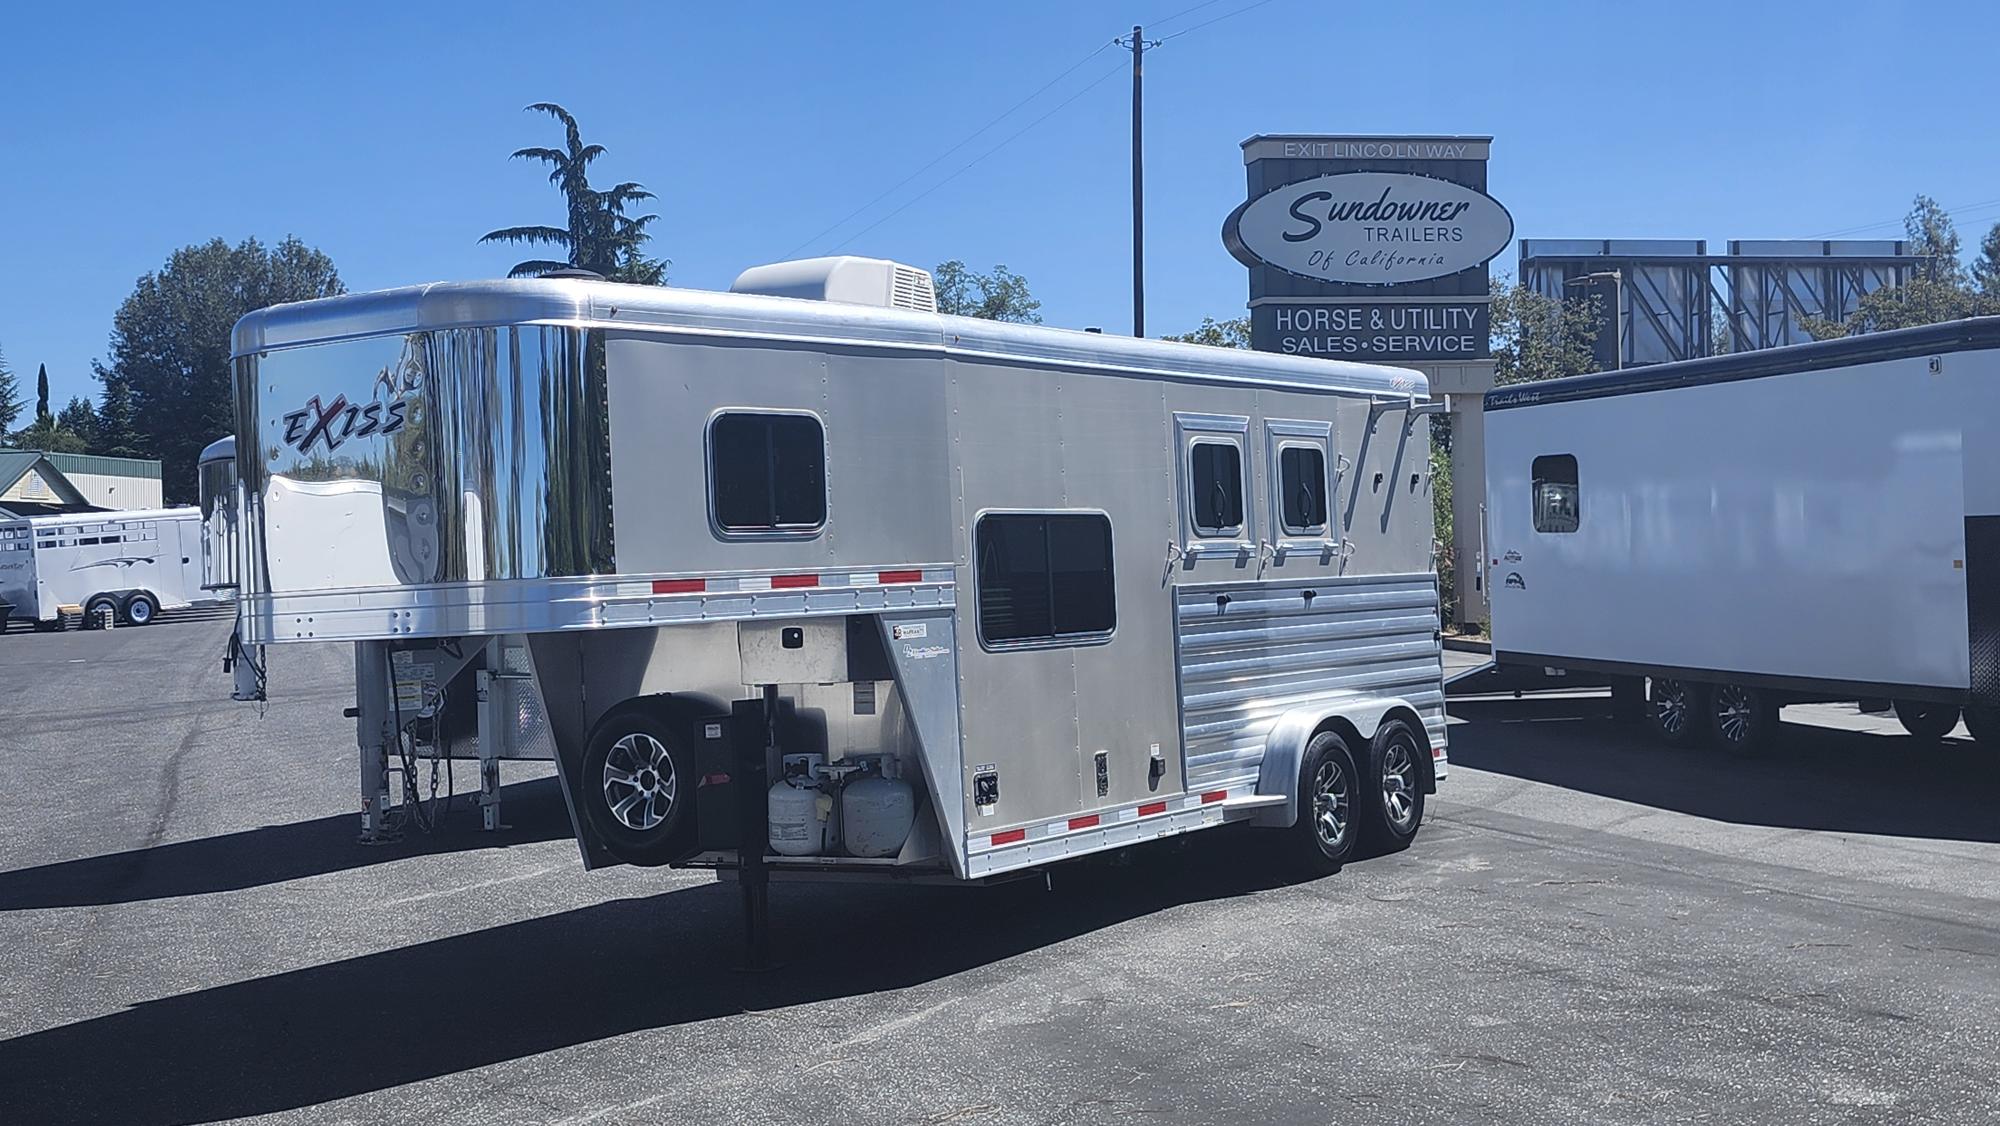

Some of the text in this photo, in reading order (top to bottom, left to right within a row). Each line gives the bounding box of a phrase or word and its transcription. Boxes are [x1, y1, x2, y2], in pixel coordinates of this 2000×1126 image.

[1284, 143, 1467, 158] EXIT LINCOLN WAY
[1282, 186, 1471, 242] Sundowner
[1364, 227, 1463, 242] TRAILERS
[1307, 250, 1444, 271] Of California
[1276, 307, 1479, 331] HORSE & UTILITY
